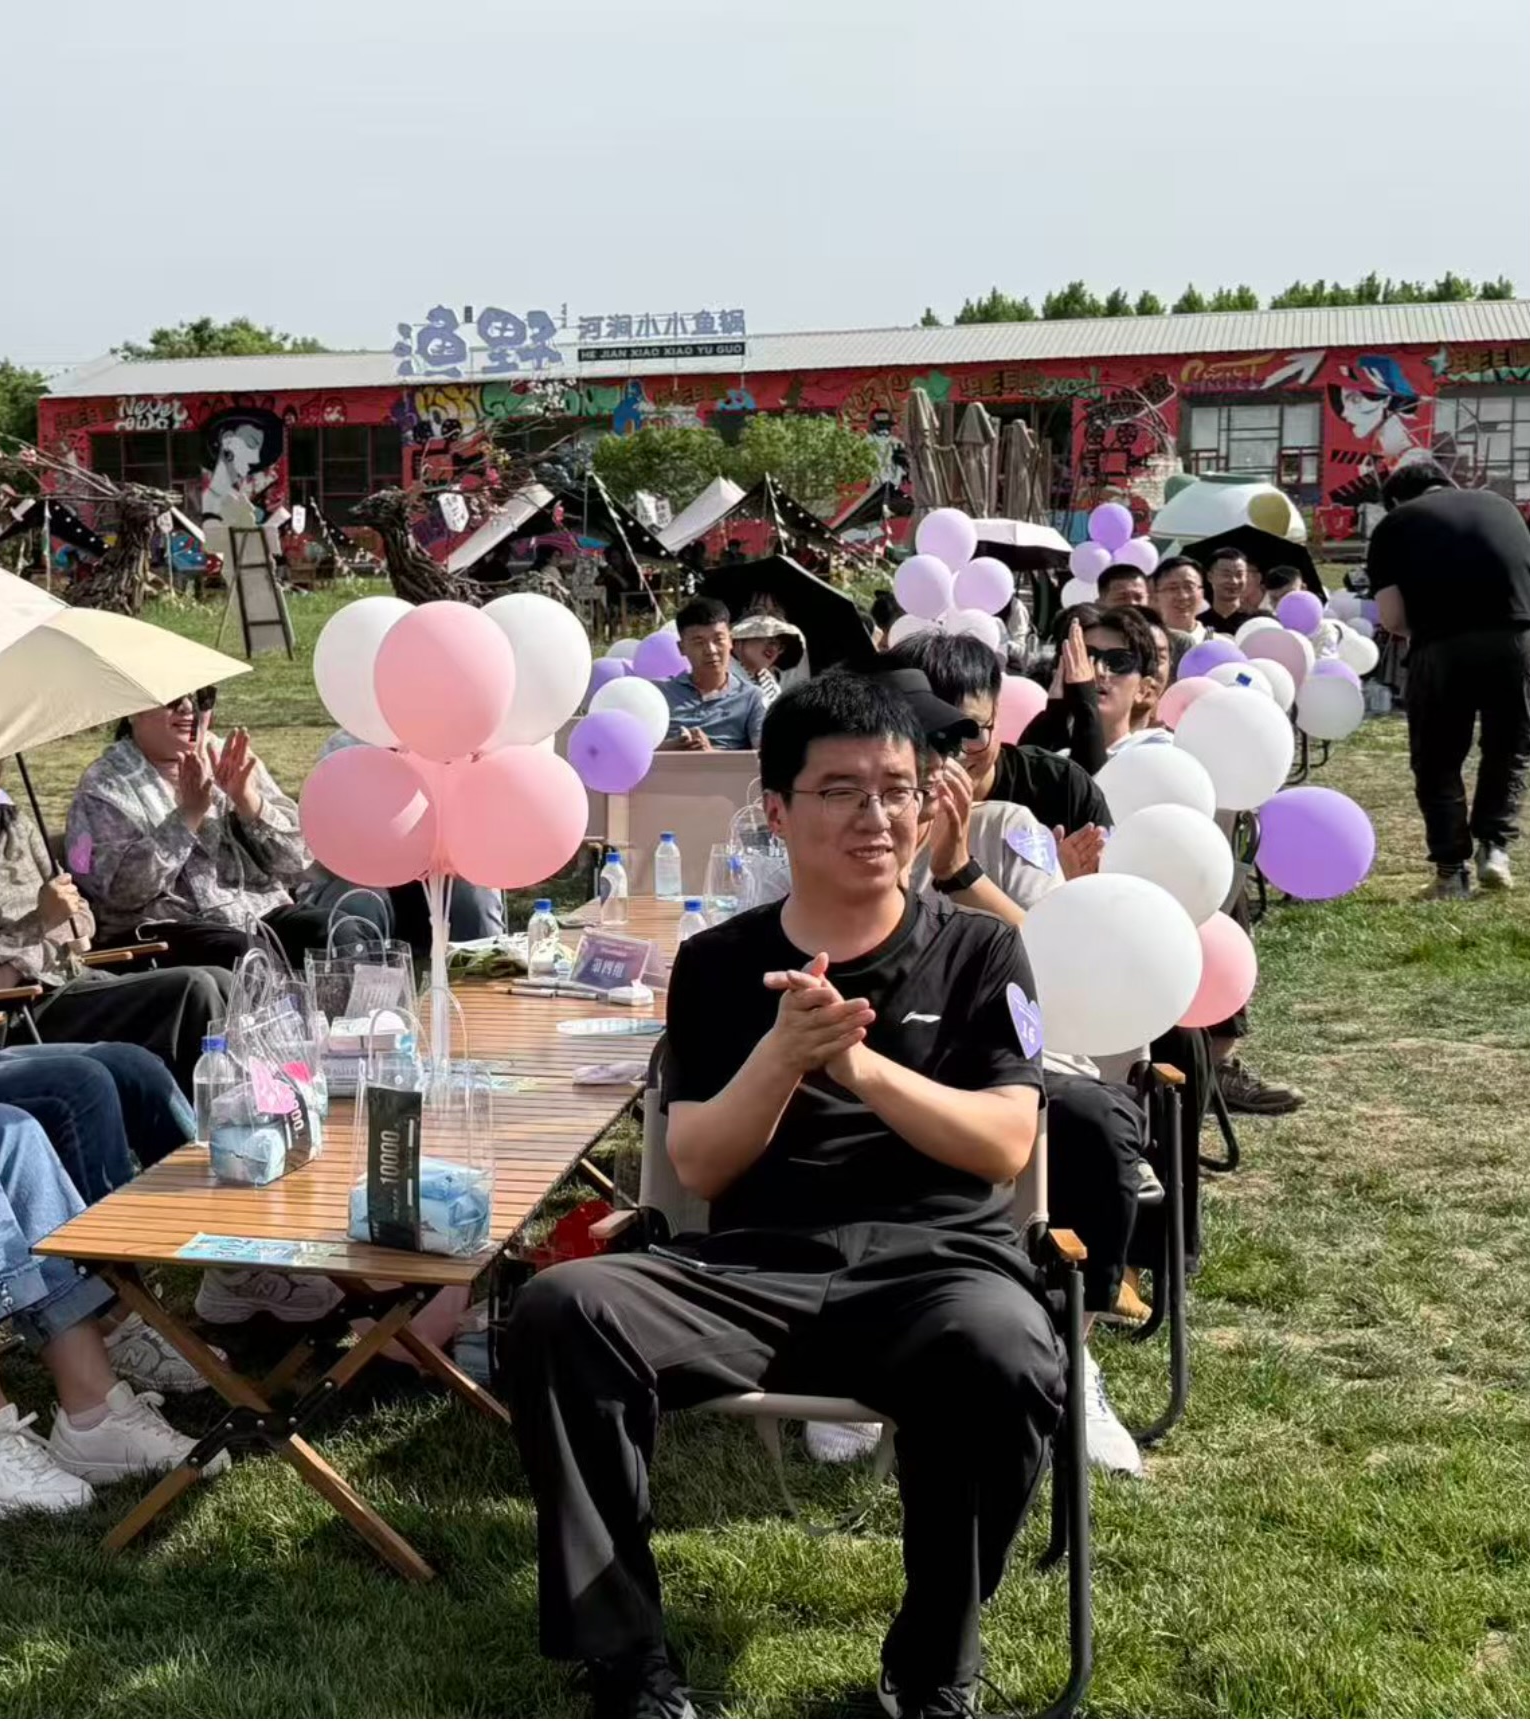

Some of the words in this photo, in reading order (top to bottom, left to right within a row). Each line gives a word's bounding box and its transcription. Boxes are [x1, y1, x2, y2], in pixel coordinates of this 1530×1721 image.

[581, 350, 596, 360] HE
[600, 349, 627, 359] JIAN
[631, 347, 660, 358] XIAO
[663, 345, 693, 356] XIAO
[697, 344, 713, 354] YU
[716, 343, 742, 354] GUO
[1021, 1021, 1036, 1043] 16
[379, 1130, 401, 1185] 10000
